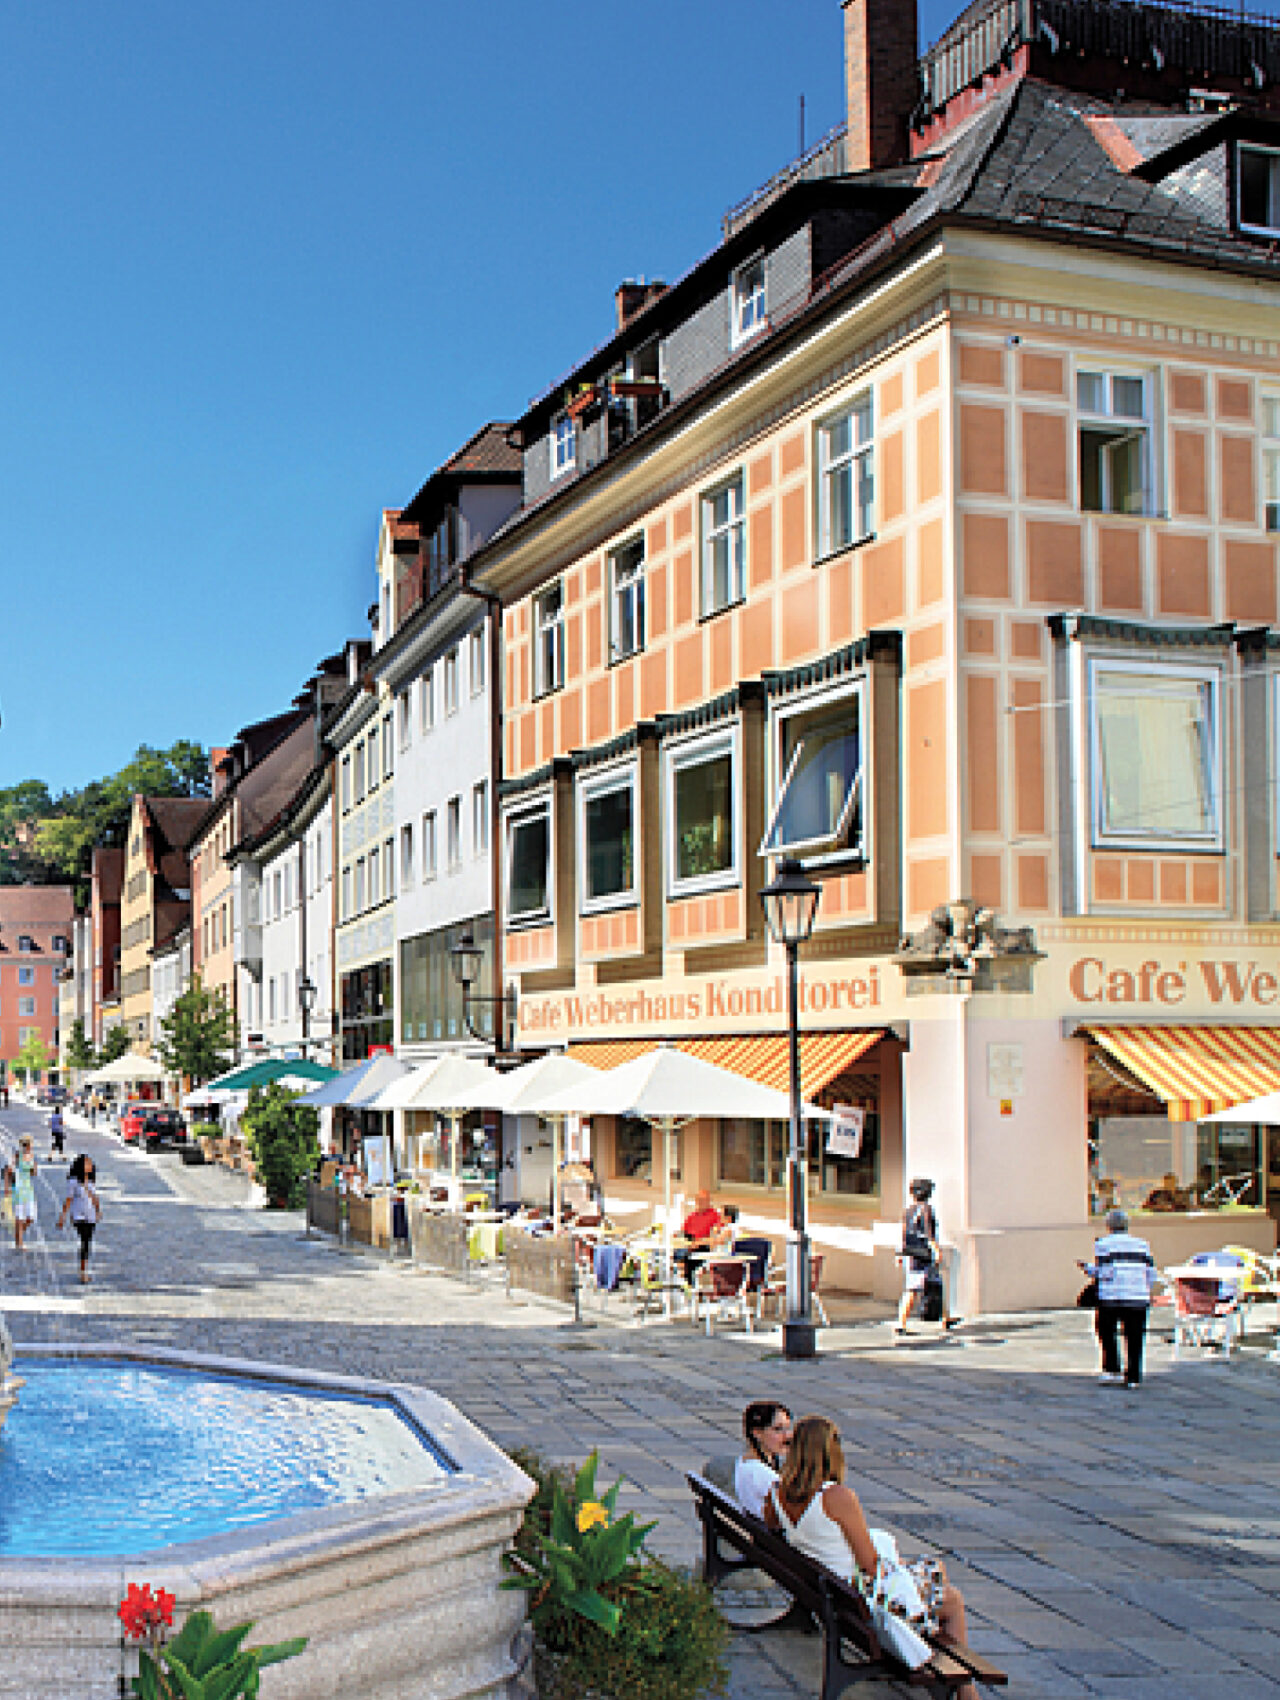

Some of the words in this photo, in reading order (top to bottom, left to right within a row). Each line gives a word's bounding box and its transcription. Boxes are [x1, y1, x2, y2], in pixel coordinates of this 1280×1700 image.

[1070, 957, 1187, 1005] Café
[1197, 961, 1280, 1005] We
[518, 1000, 562, 1031] Café
[564, 990, 700, 1027] Weberhaus
